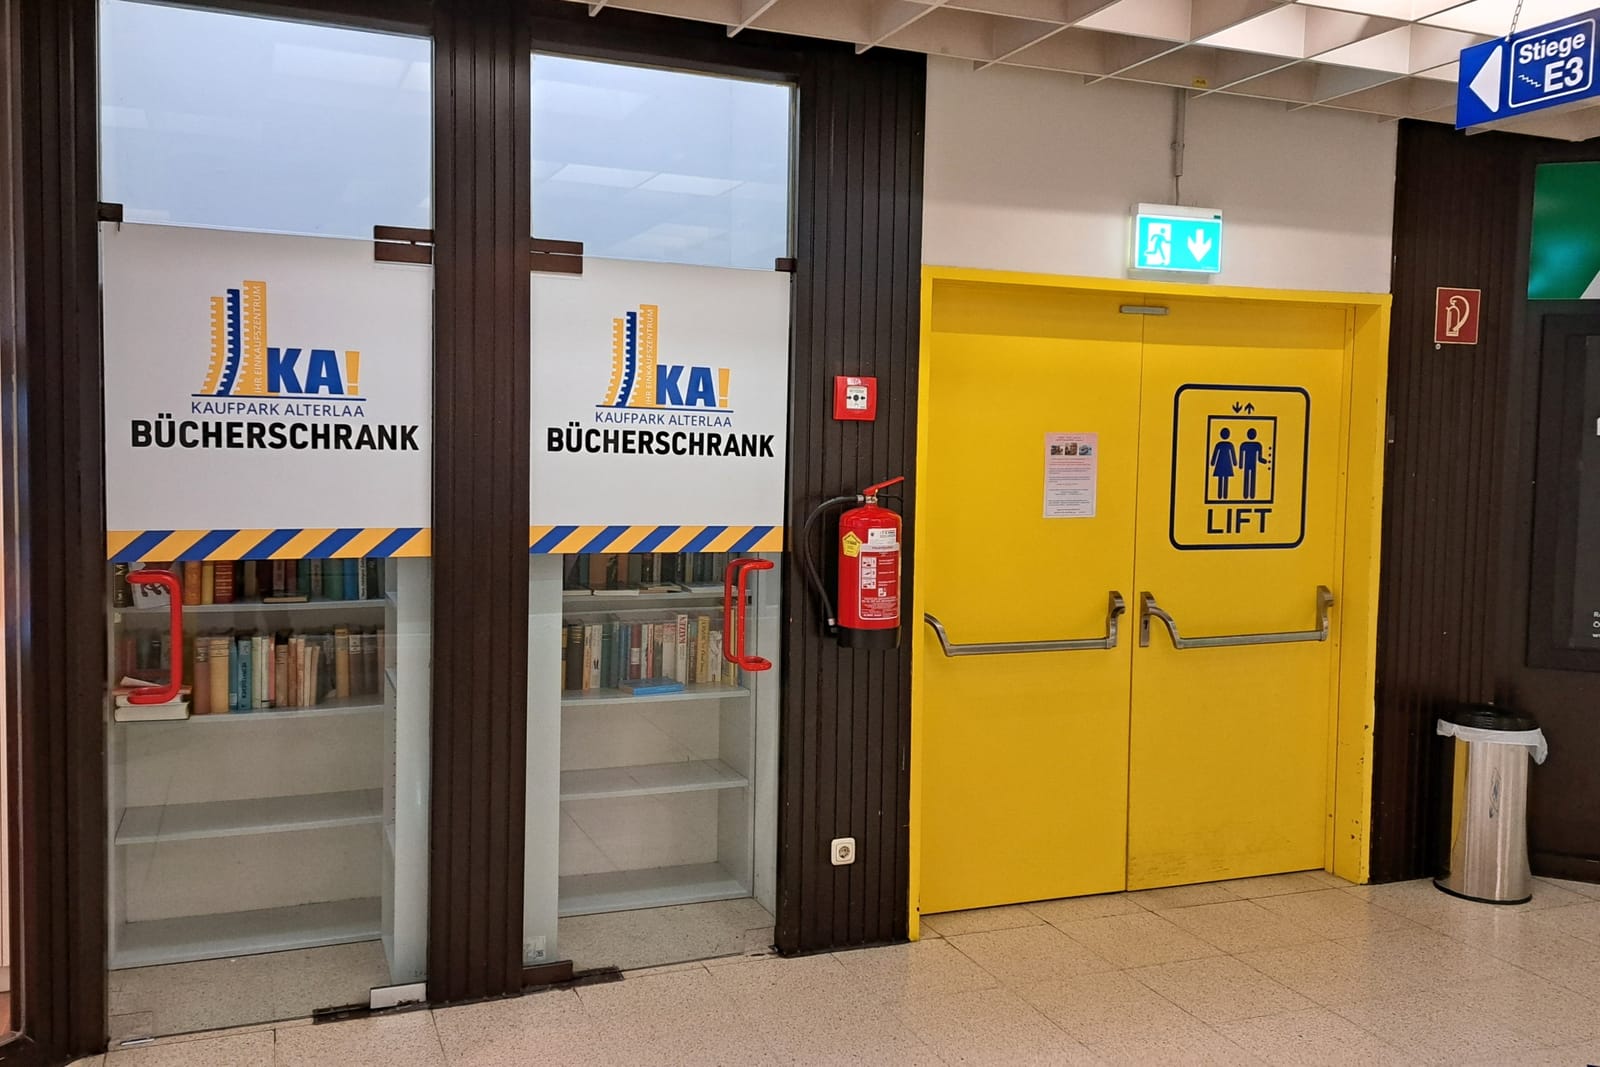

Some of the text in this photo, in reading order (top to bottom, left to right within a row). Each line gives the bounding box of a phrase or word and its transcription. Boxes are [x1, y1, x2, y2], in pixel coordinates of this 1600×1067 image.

[1518, 33, 1586, 64] Stiege
[1544, 56, 1584, 93] E3
[253, 286, 262, 393] IHR EINKAUFSZENTRUM
[645, 309, 654, 389] EINKAUFSZENTRUM
[191, 401, 365, 417] KAUFPARK ALTERLAA
[595, 411, 732, 428] KAUFPARK ALTERLAA
[131, 413, 419, 451] BÜCHERSCHRANK
[546, 421, 775, 457] BÜCHERSCHRANK
[1207, 508, 1272, 534] LIFT
